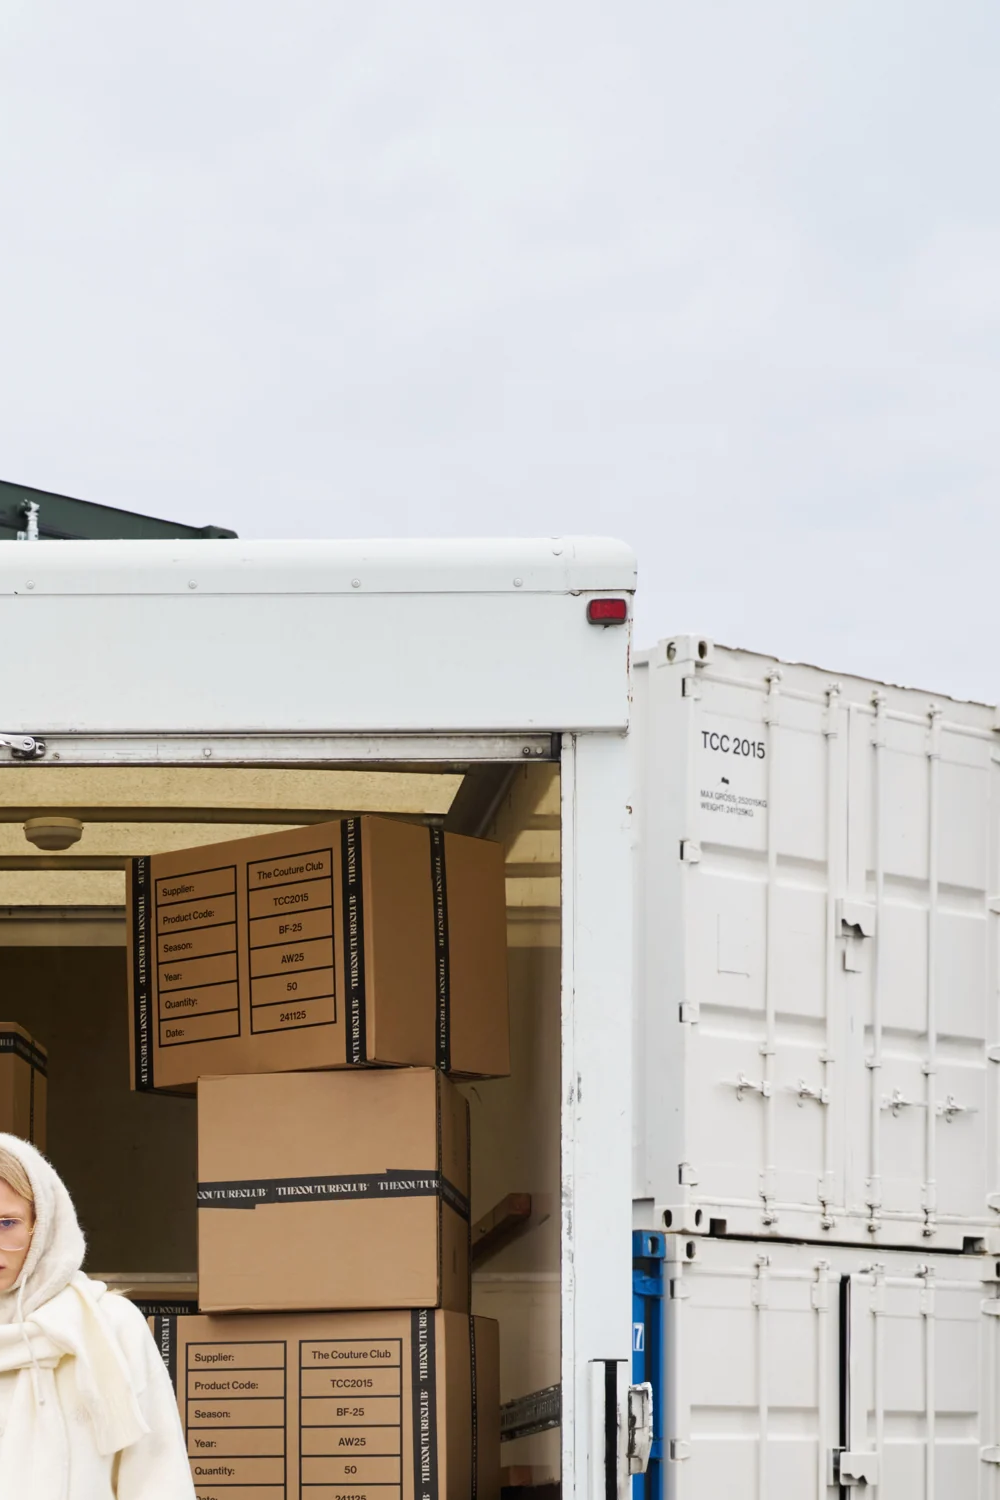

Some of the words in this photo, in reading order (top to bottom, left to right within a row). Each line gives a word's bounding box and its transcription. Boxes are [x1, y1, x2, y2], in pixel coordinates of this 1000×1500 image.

[701, 730, 730, 753] TCC
[733, 737, 766, 760] 2015
[700, 789, 714, 799] MAX
[257, 869, 272, 880] The
[273, 865, 304, 878] Couture
[305, 861, 324, 872] Club
[162, 884, 194, 897] Supplier:
[273, 893, 309, 907] TCC2015
[163, 911, 192, 925] Product
[192, 909, 215, 919] Code:
[279, 923, 303, 934] BF-25
[163, 941, 193, 953] Season:
[281, 952, 305, 964] AW25
[164, 972, 182, 982] Year:
[286, 982, 297, 991] 50
[164, 998, 198, 1010] Quantity:
[280, 1010, 307, 1022] 241125
[165, 1029, 185, 1038] Date:
[635, 1324, 643, 1350] 7
[194, 1353, 235, 1363] Supplier:
[312, 1350, 330, 1360] The
[331, 1350, 368, 1359] Couture
[369, 1349, 391, 1359] Club
[194, 1381, 231, 1391] Product
[234, 1380, 259, 1390] Code:
[330, 1379, 373, 1388] TCC2015
[194, 1409, 231, 1419] Season:
[336, 1407, 365, 1417] BF-25
[194, 1439, 217, 1448] Year:
[338, 1437, 367, 1447] AW25
[194, 1466, 235, 1477] Quantity:
[344, 1466, 357, 1475] 50
